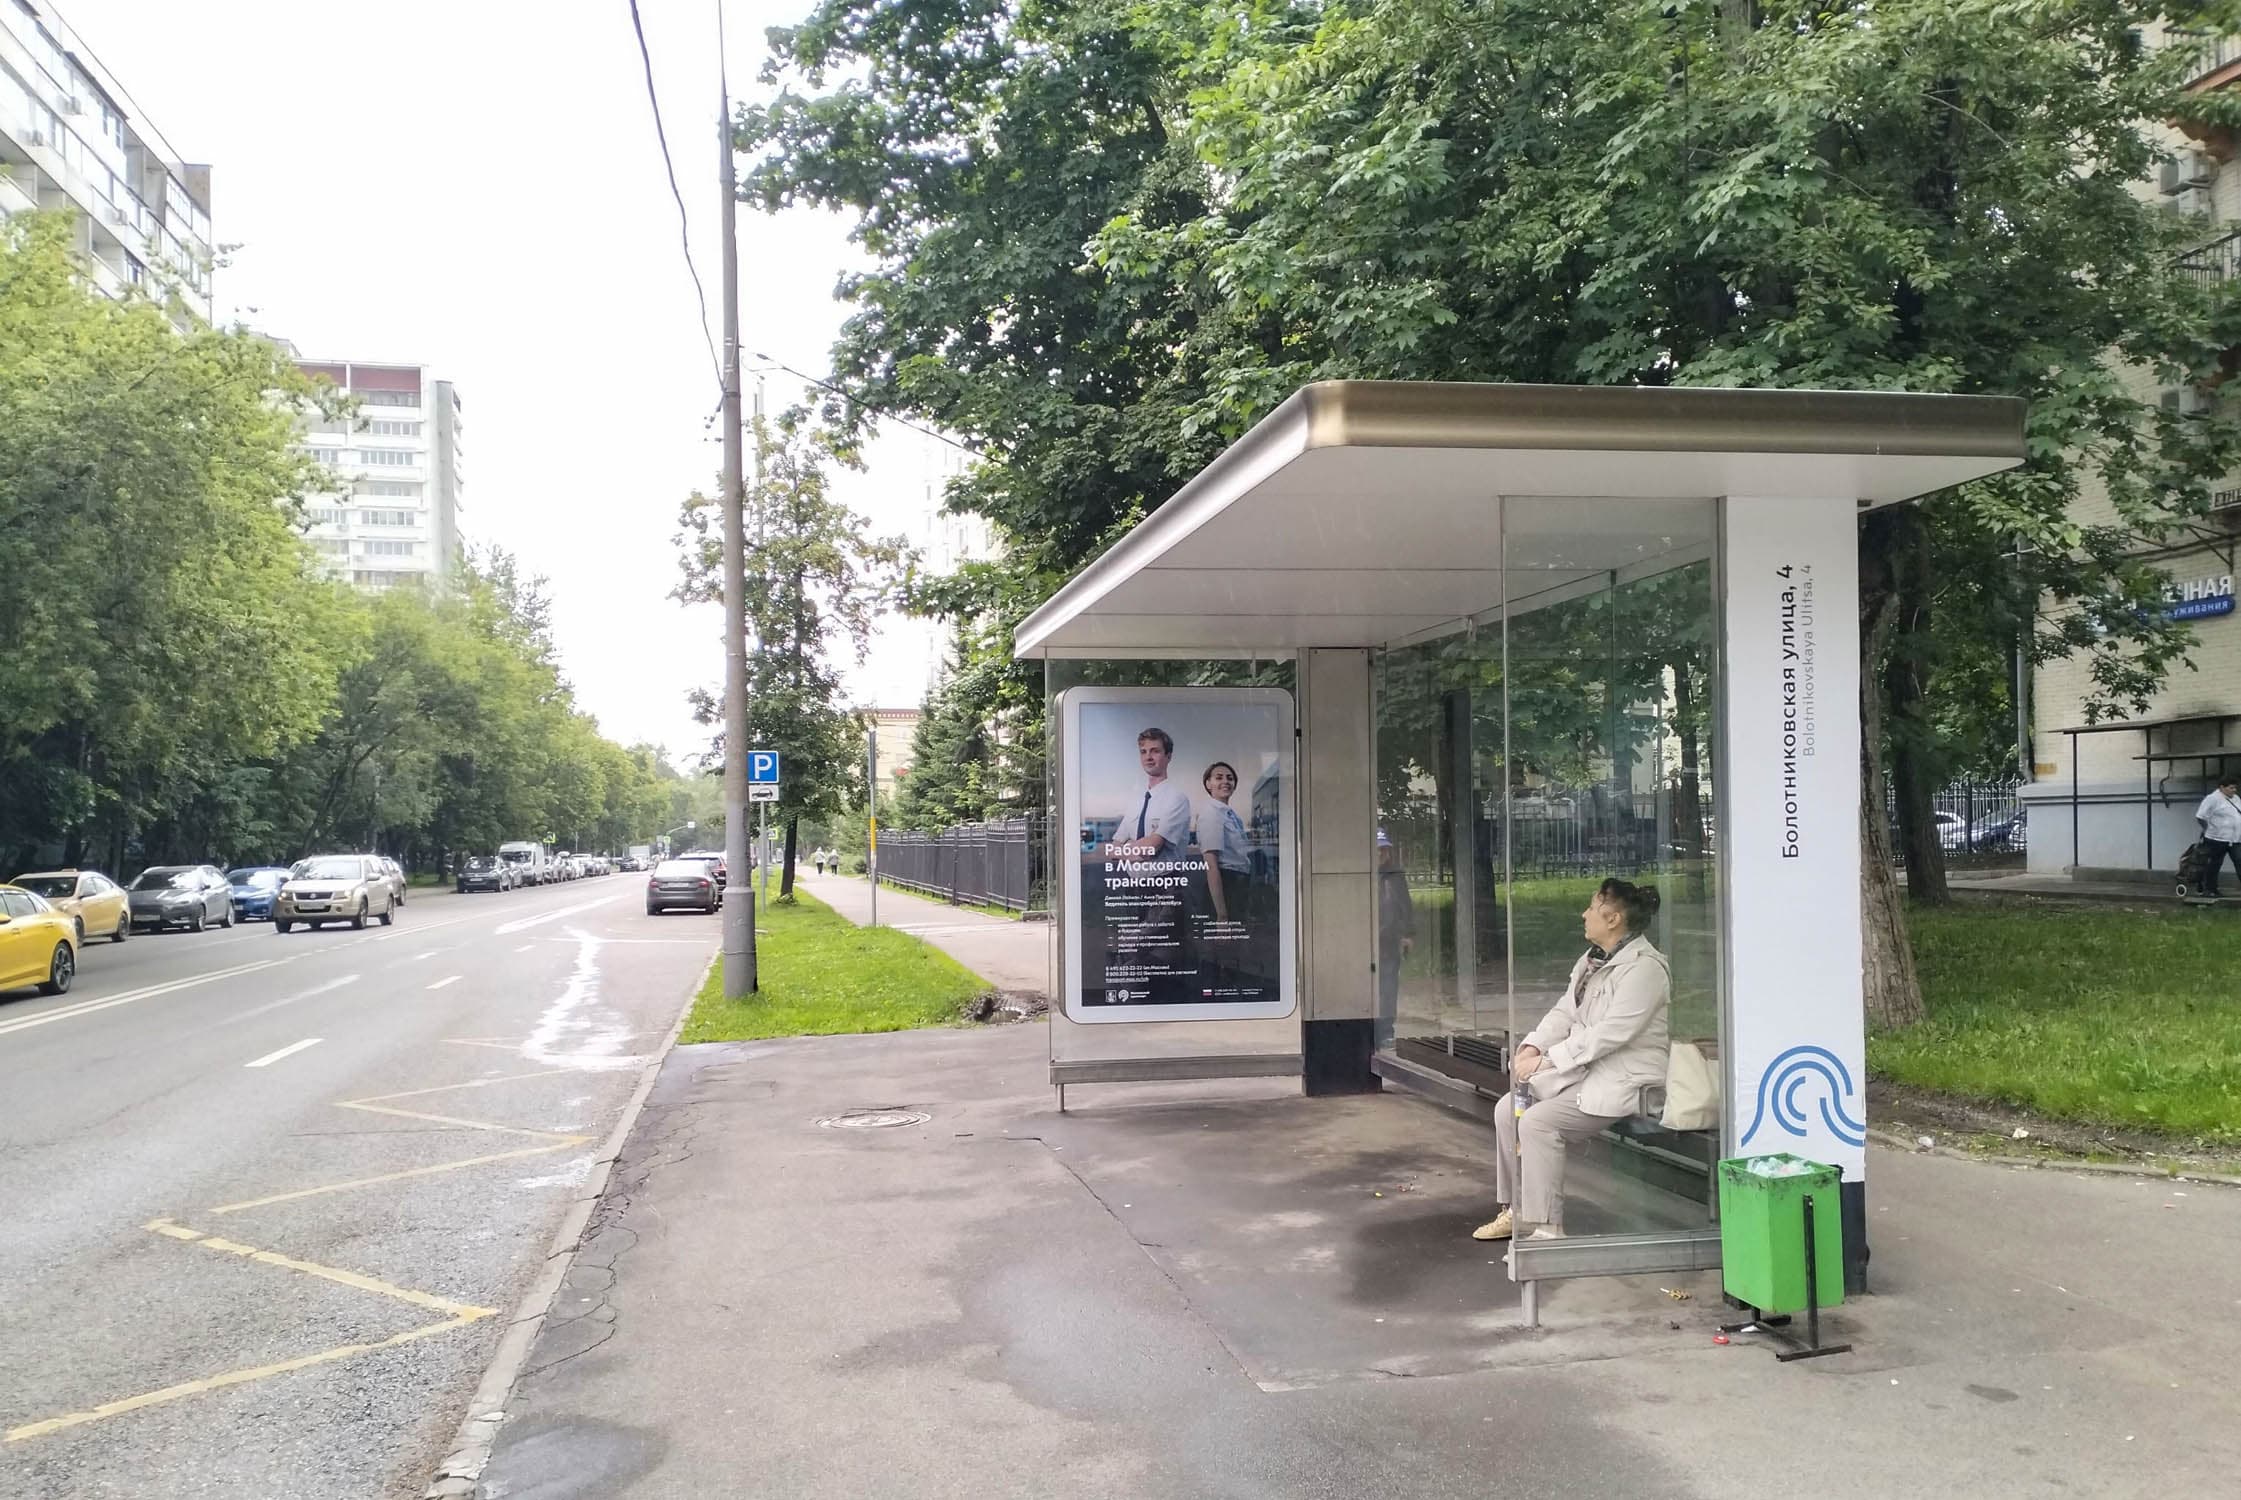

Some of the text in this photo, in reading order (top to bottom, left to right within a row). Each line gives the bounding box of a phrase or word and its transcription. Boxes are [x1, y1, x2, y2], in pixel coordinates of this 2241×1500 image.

[1800, 564, 1815, 756] Bolotnikovskaya Ulitsa, 4
[1776, 563, 1800, 858] Болотниковская улица, 4
[1105, 844, 1155, 856] Работа
[1105, 859, 1210, 872] в Московском
[1105, 877, 1188, 889] транспорте
